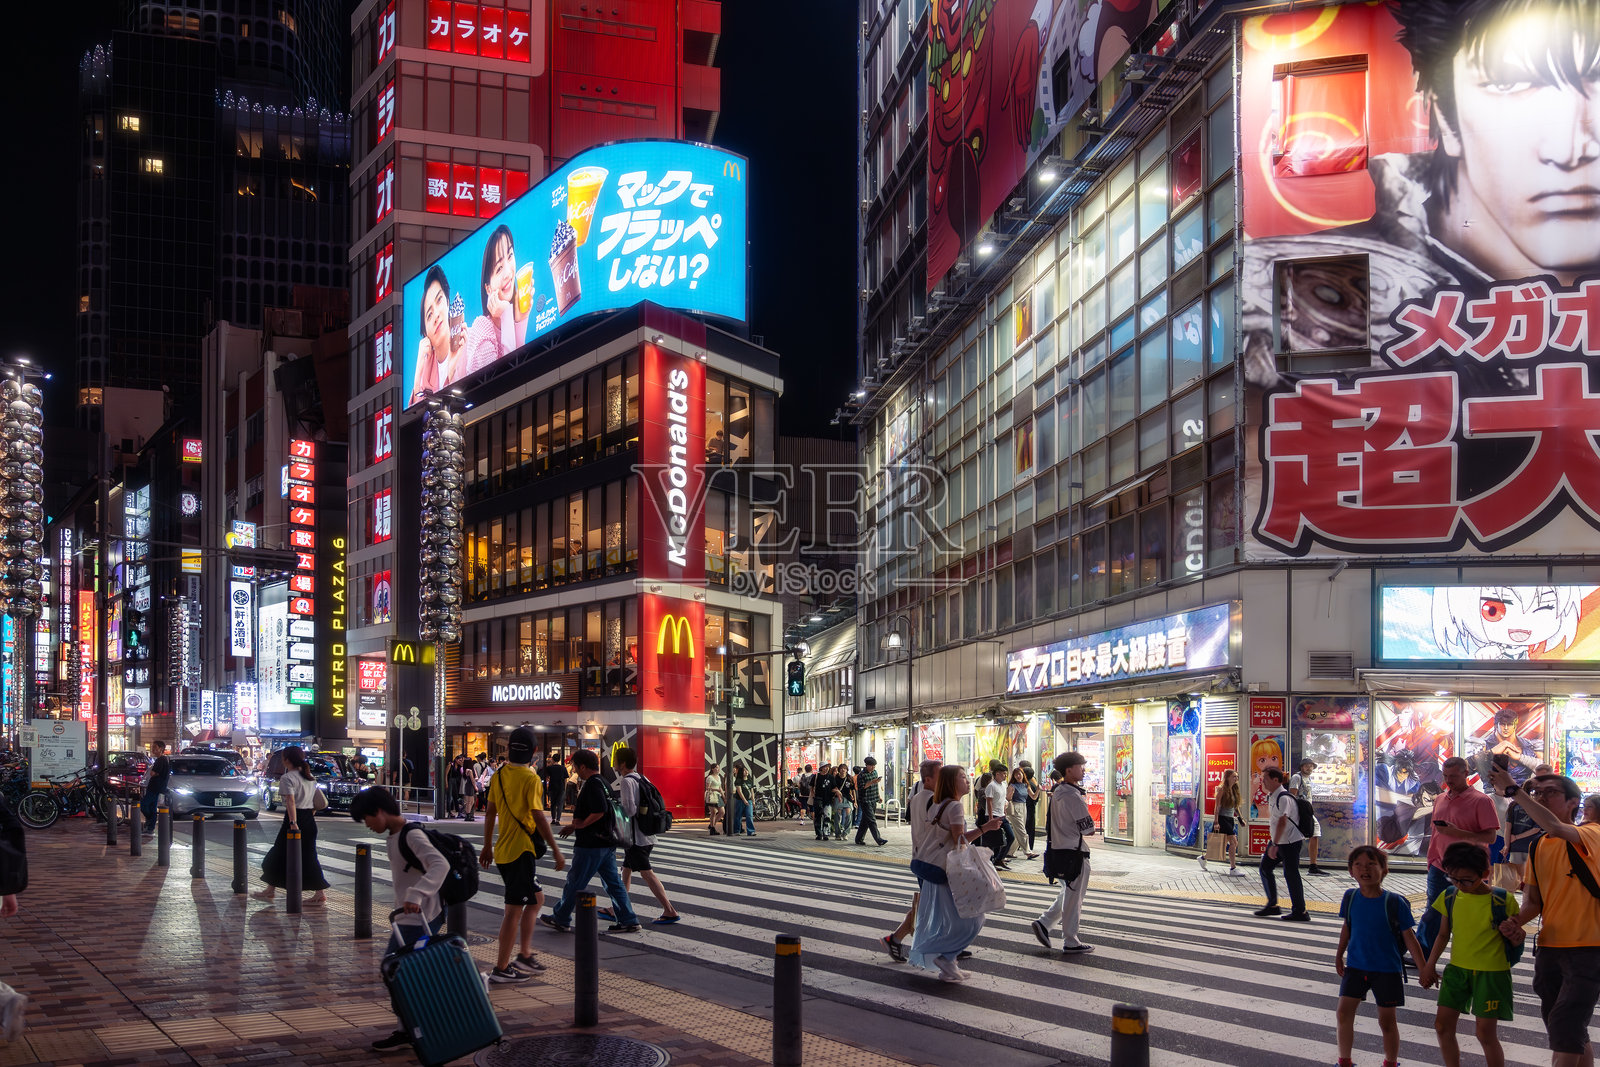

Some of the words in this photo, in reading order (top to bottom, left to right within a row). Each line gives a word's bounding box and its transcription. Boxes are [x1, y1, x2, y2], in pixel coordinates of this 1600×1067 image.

[431, 16, 529, 47] カラオケ
[428, 177, 502, 205] 歌広場
[616, 170, 714, 209] マックで
[597, 209, 723, 261] フラッペ
[666, 368, 689, 568] McDonald's
[82, 602, 91, 641] パチンコ
[233, 605, 246, 650] 一軒め酒場
[333, 643, 345, 717] METRO
[360, 662, 387, 671] カラオ
[491, 681, 562, 702] McDonald's
[1253, 710, 1281, 718] エスパス
[1483, 999, 1498, 1013] 10
